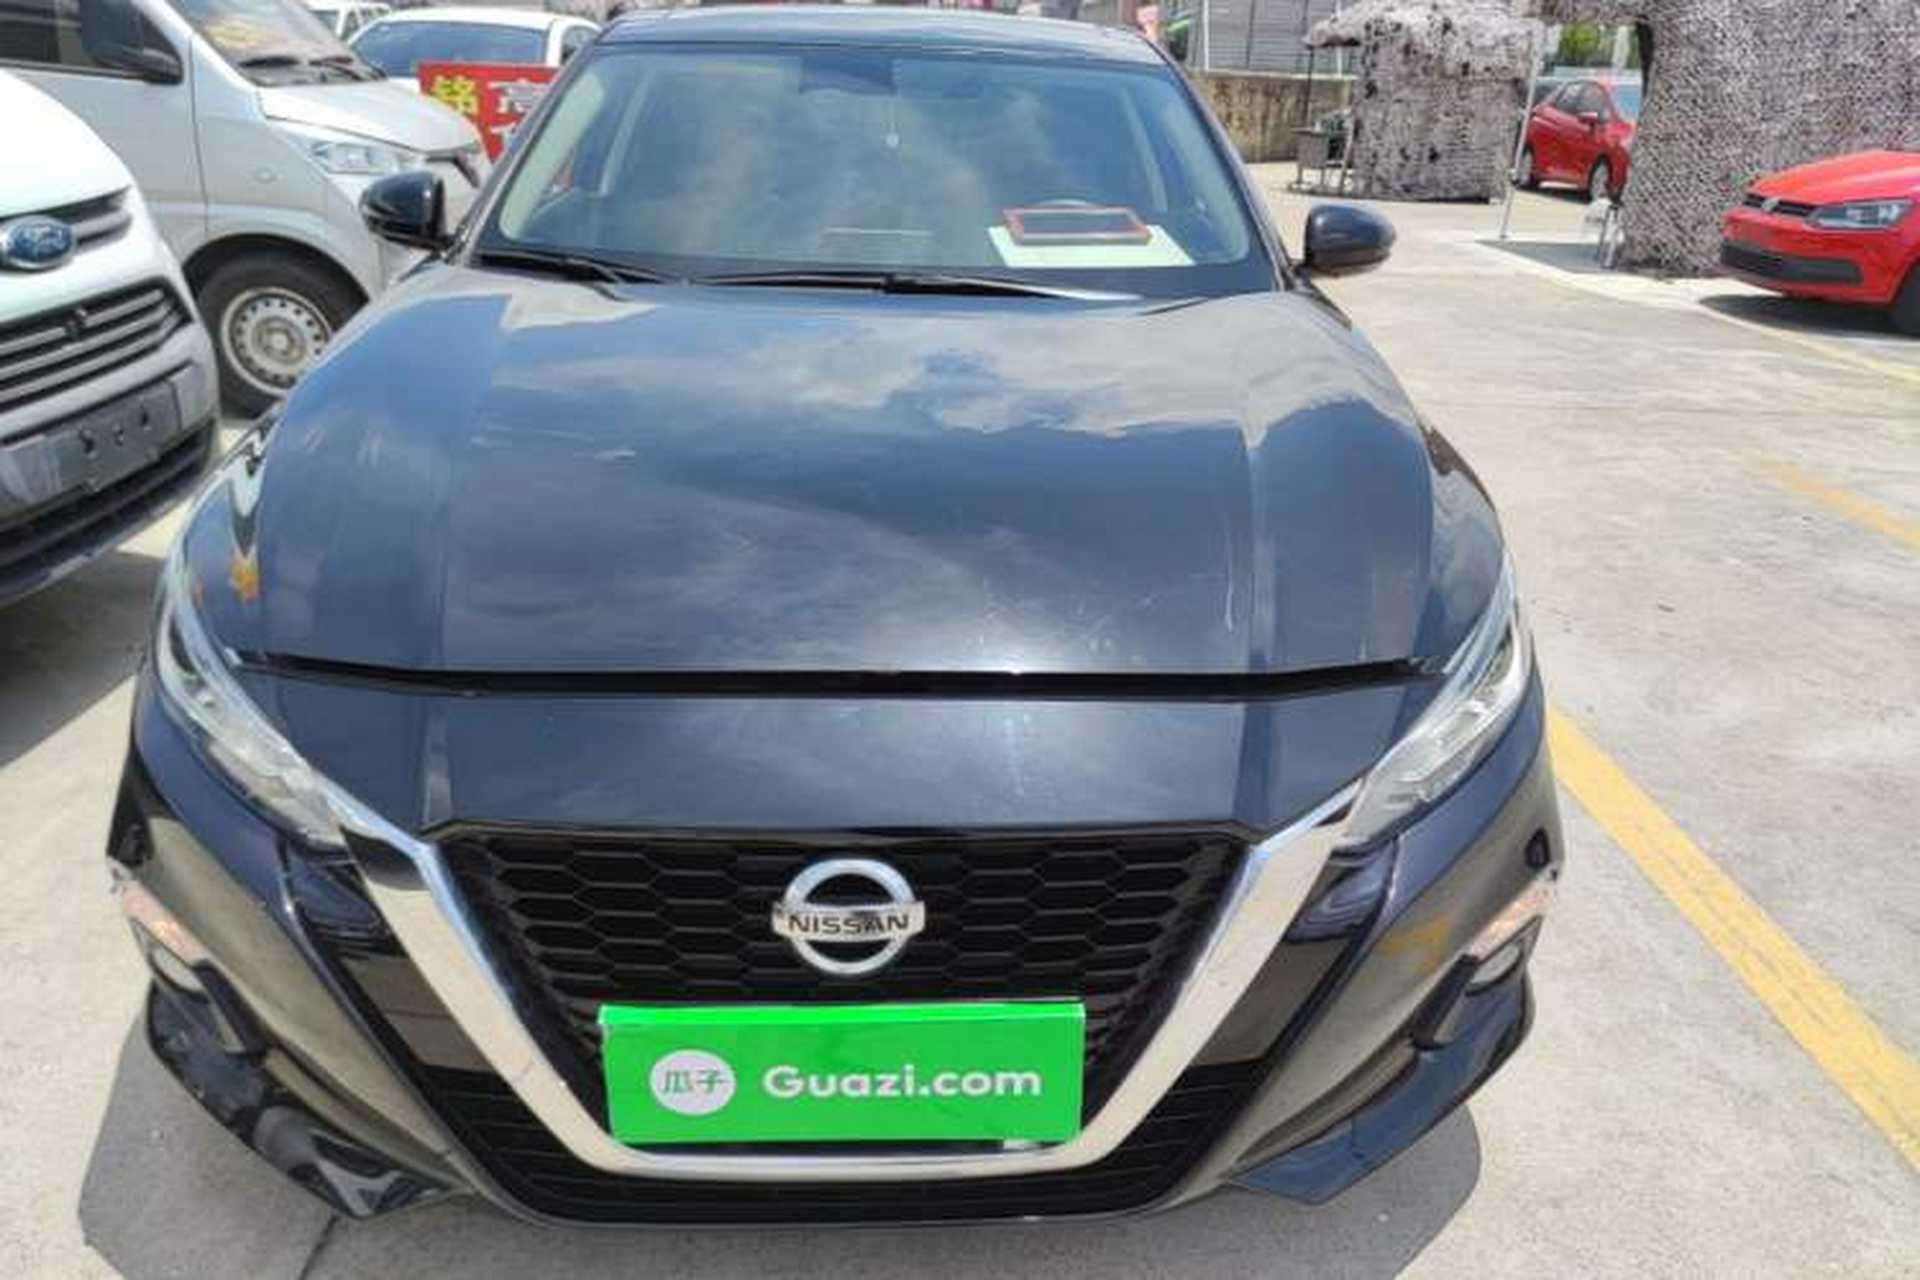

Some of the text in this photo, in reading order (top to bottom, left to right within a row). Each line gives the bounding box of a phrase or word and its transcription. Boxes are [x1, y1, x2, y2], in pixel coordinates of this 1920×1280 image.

[787, 913, 910, 935] NISSAN
[661, 1068, 732, 1095] 瓜子
[762, 1064, 1042, 1099] Guazi.com
